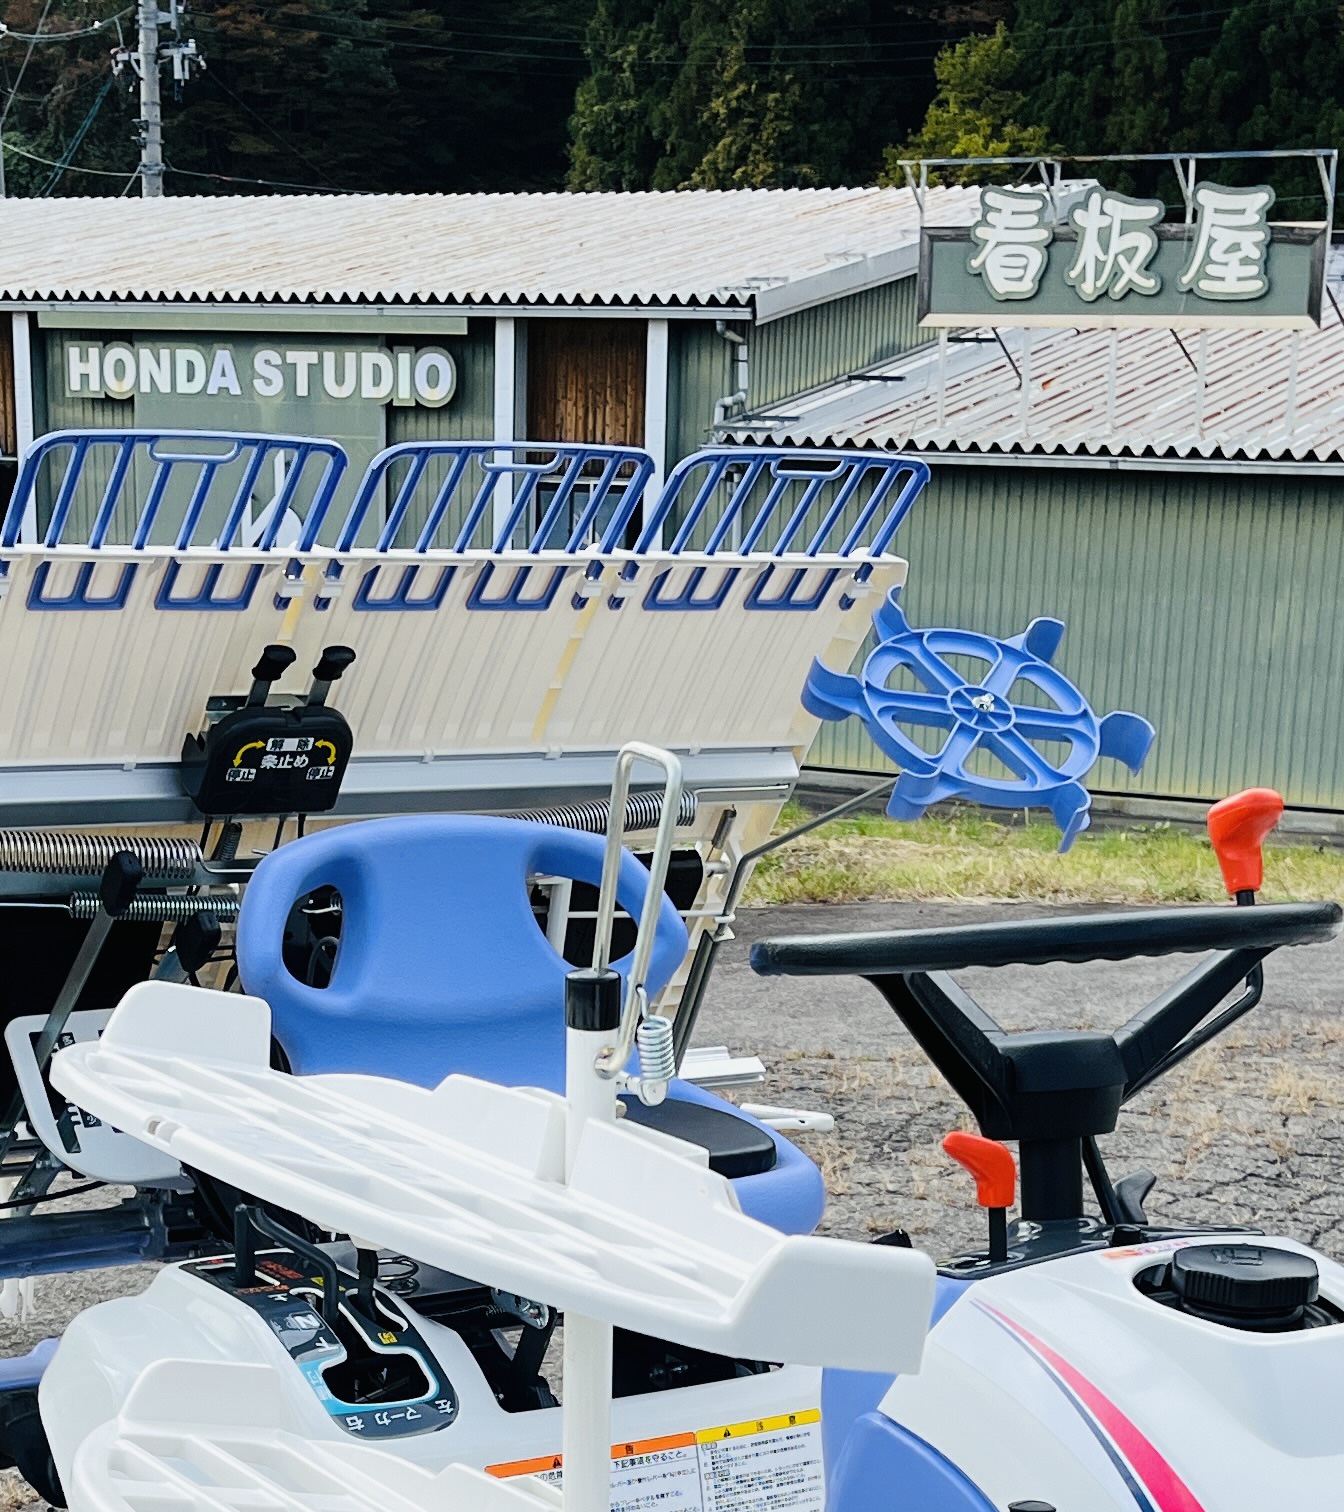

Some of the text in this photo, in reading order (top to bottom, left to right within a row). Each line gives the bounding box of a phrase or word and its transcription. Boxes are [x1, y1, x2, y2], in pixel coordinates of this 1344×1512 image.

[970, 188, 1270, 294] 看板屋
[67, 346, 454, 402] HONDA STUDIO
[269, 738, 311, 751] 解除
[227, 765, 334, 782] 停止 停止
[261, 754, 309, 769] 条止め
[345, 1399, 455, 1431] 左 マーカ 右
